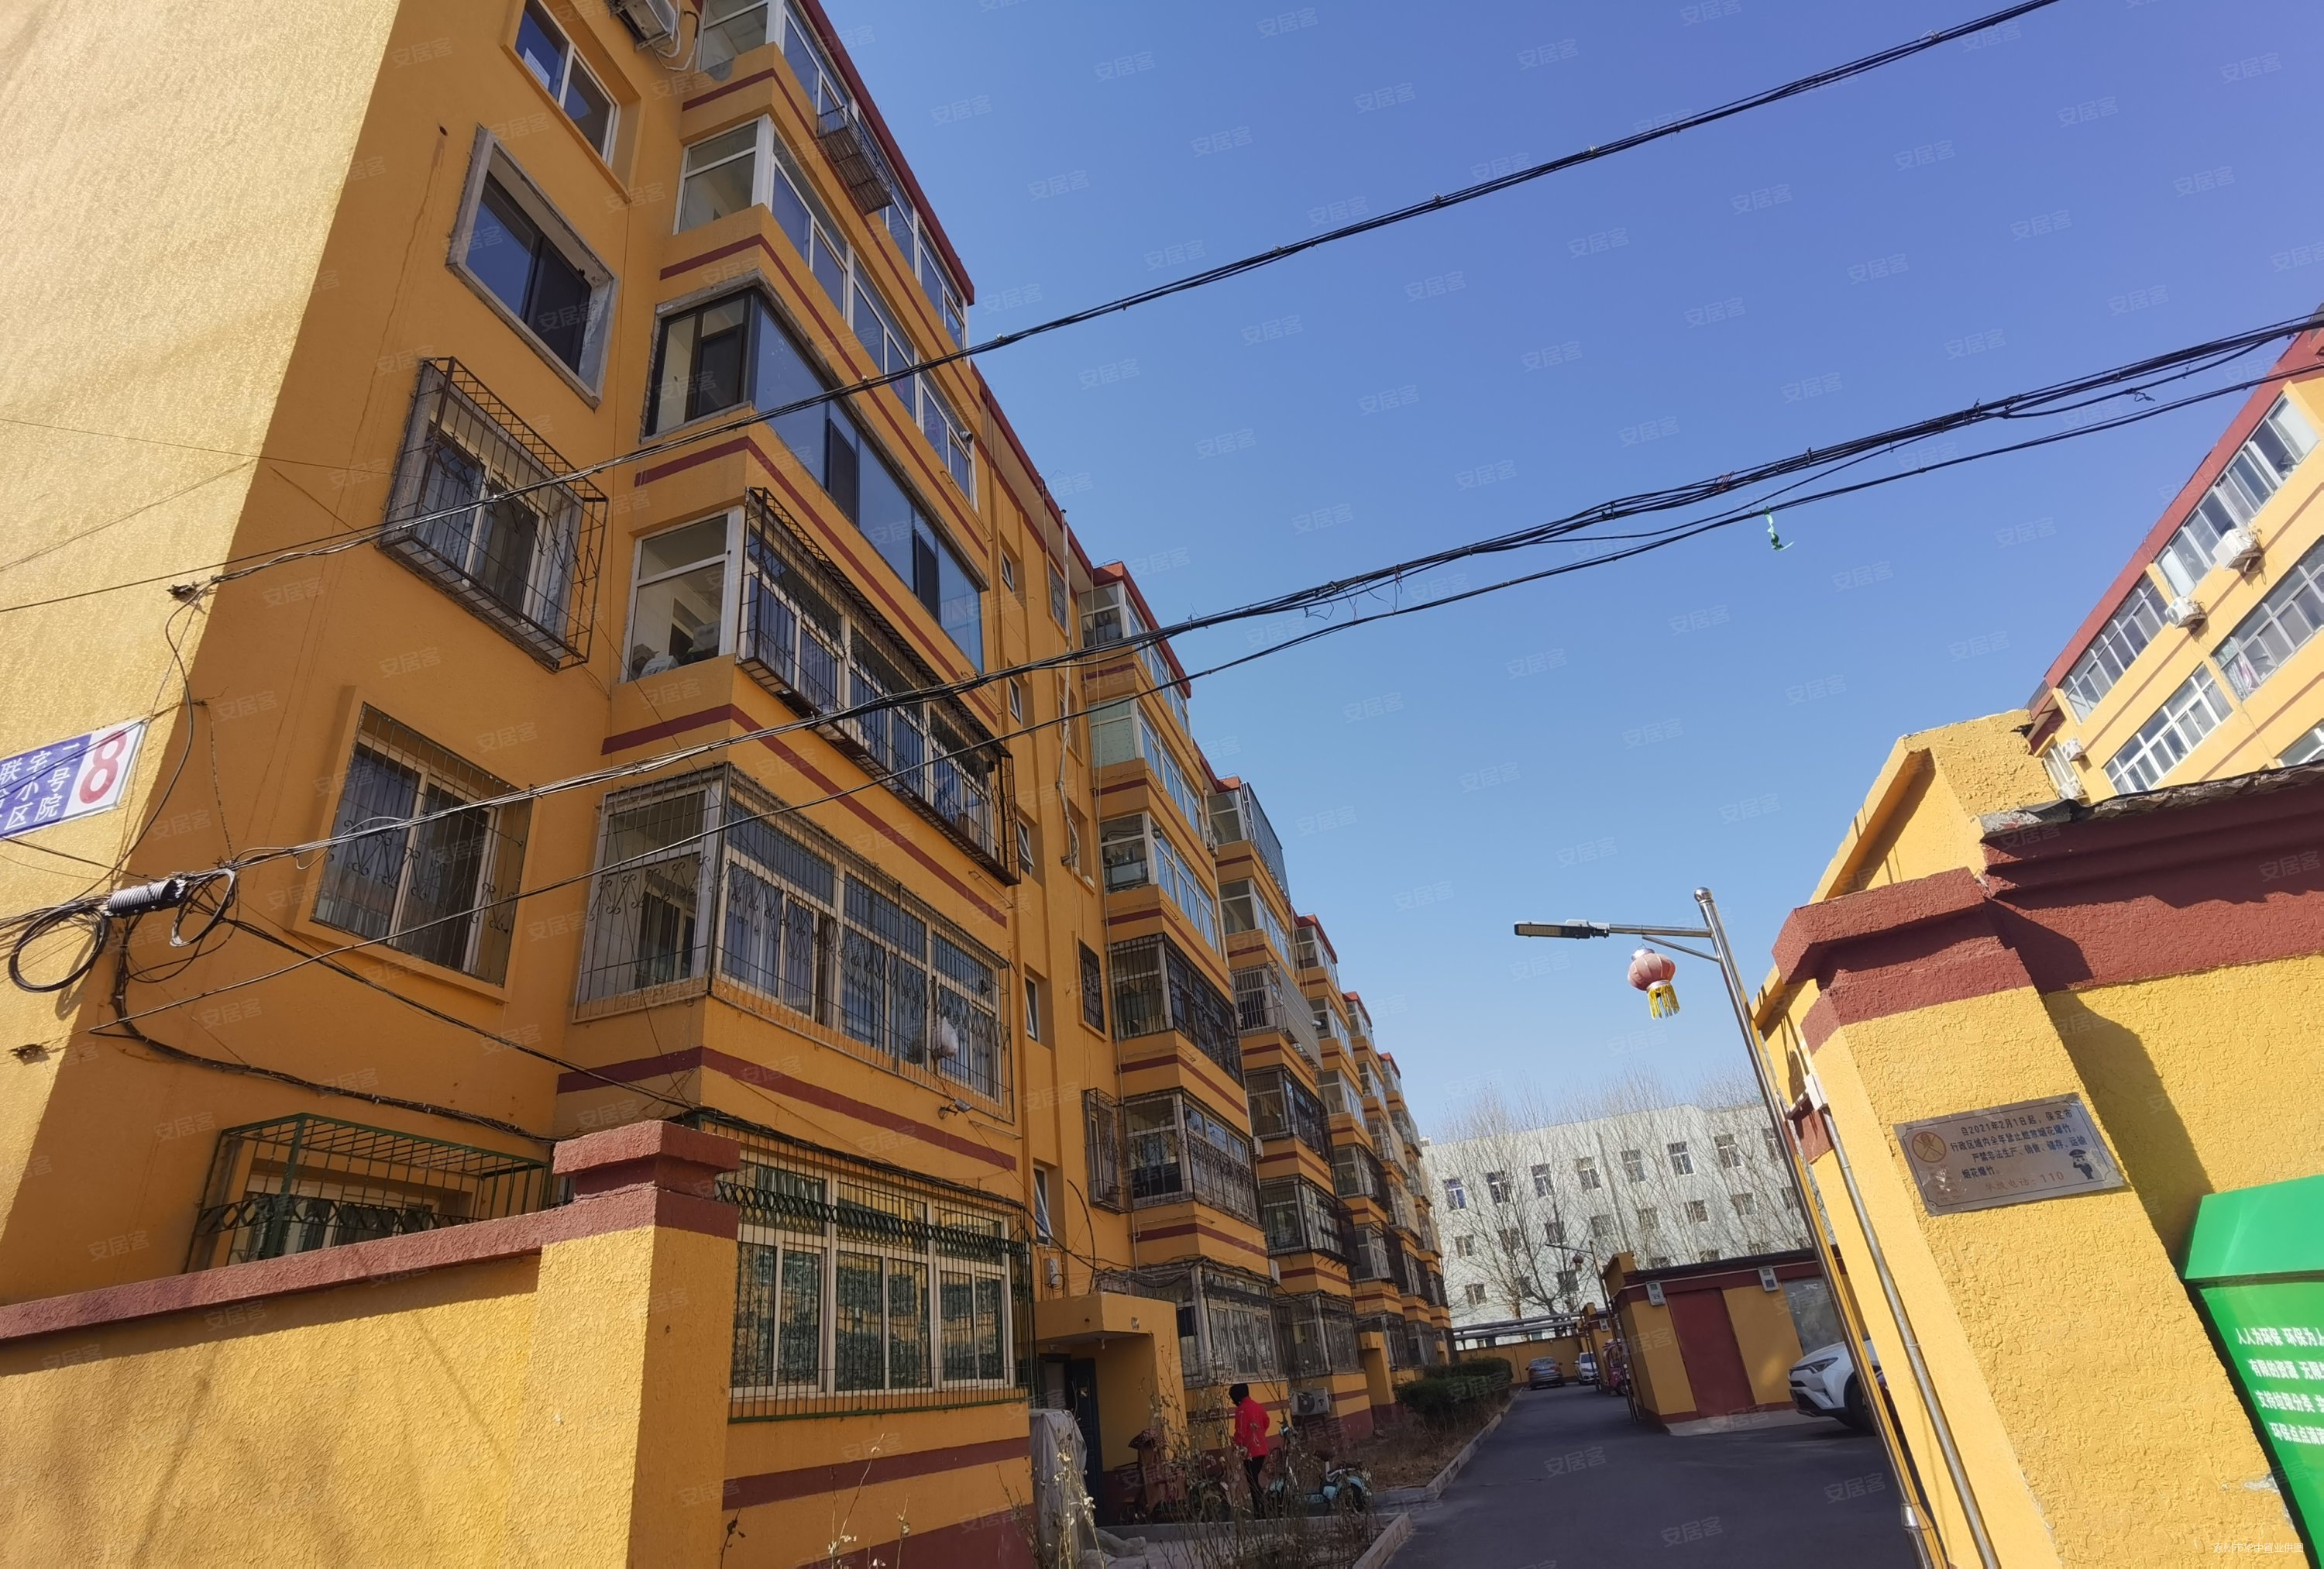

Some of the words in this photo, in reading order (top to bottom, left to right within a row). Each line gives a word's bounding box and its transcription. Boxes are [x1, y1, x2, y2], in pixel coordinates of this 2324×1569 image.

[79, 730, 127, 804] 8
[2235, 1326, 2284, 1347] 人人为环保
[2247, 1358, 2300, 1380] 有限的资源
[2254, 1388, 2316, 1413] 支持垃圾分类
